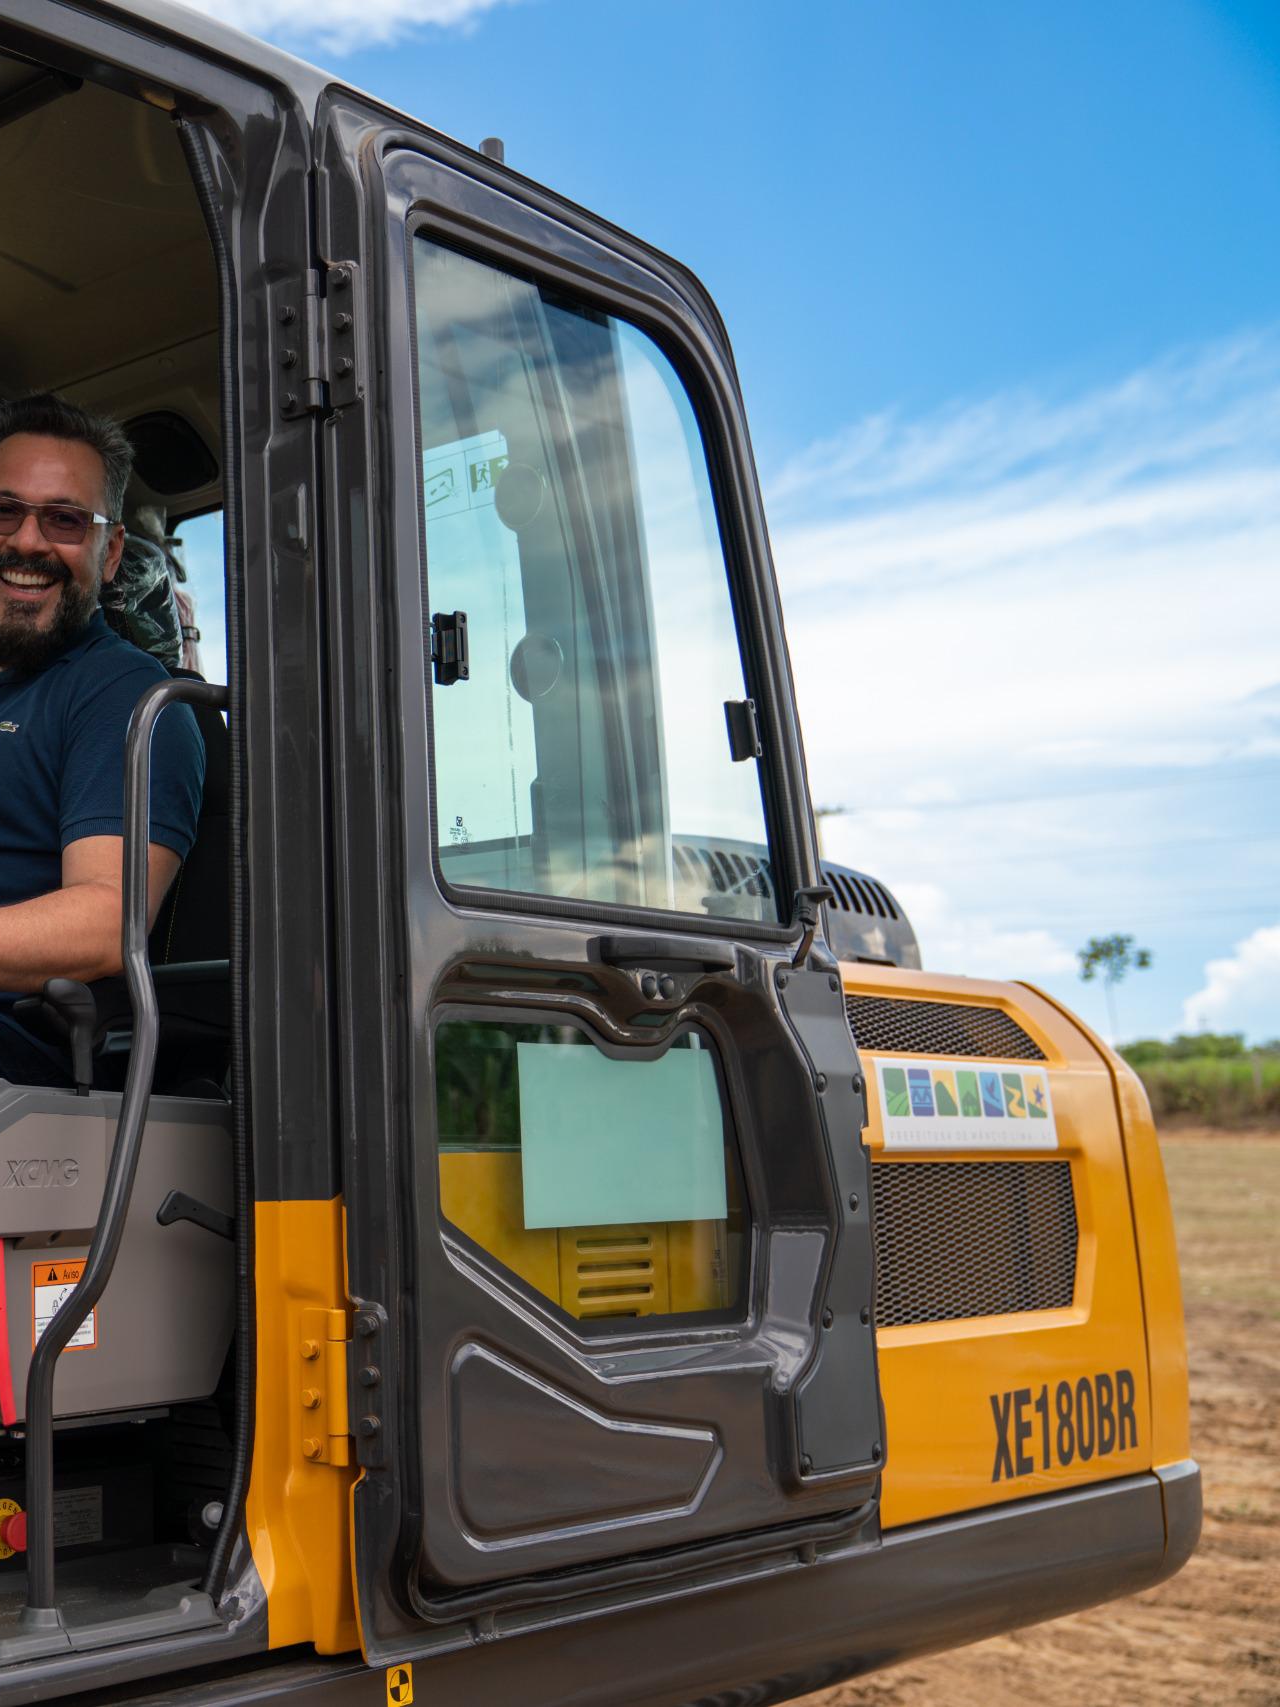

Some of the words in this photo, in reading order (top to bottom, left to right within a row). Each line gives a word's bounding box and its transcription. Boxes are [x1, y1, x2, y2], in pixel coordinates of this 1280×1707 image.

[889, 1129, 951, 1142] PREFEITURA
[3, 1158, 80, 1189] XCMG
[62, 1268, 80, 1280] Aviso
[990, 1368, 1138, 1483] XE180BR
